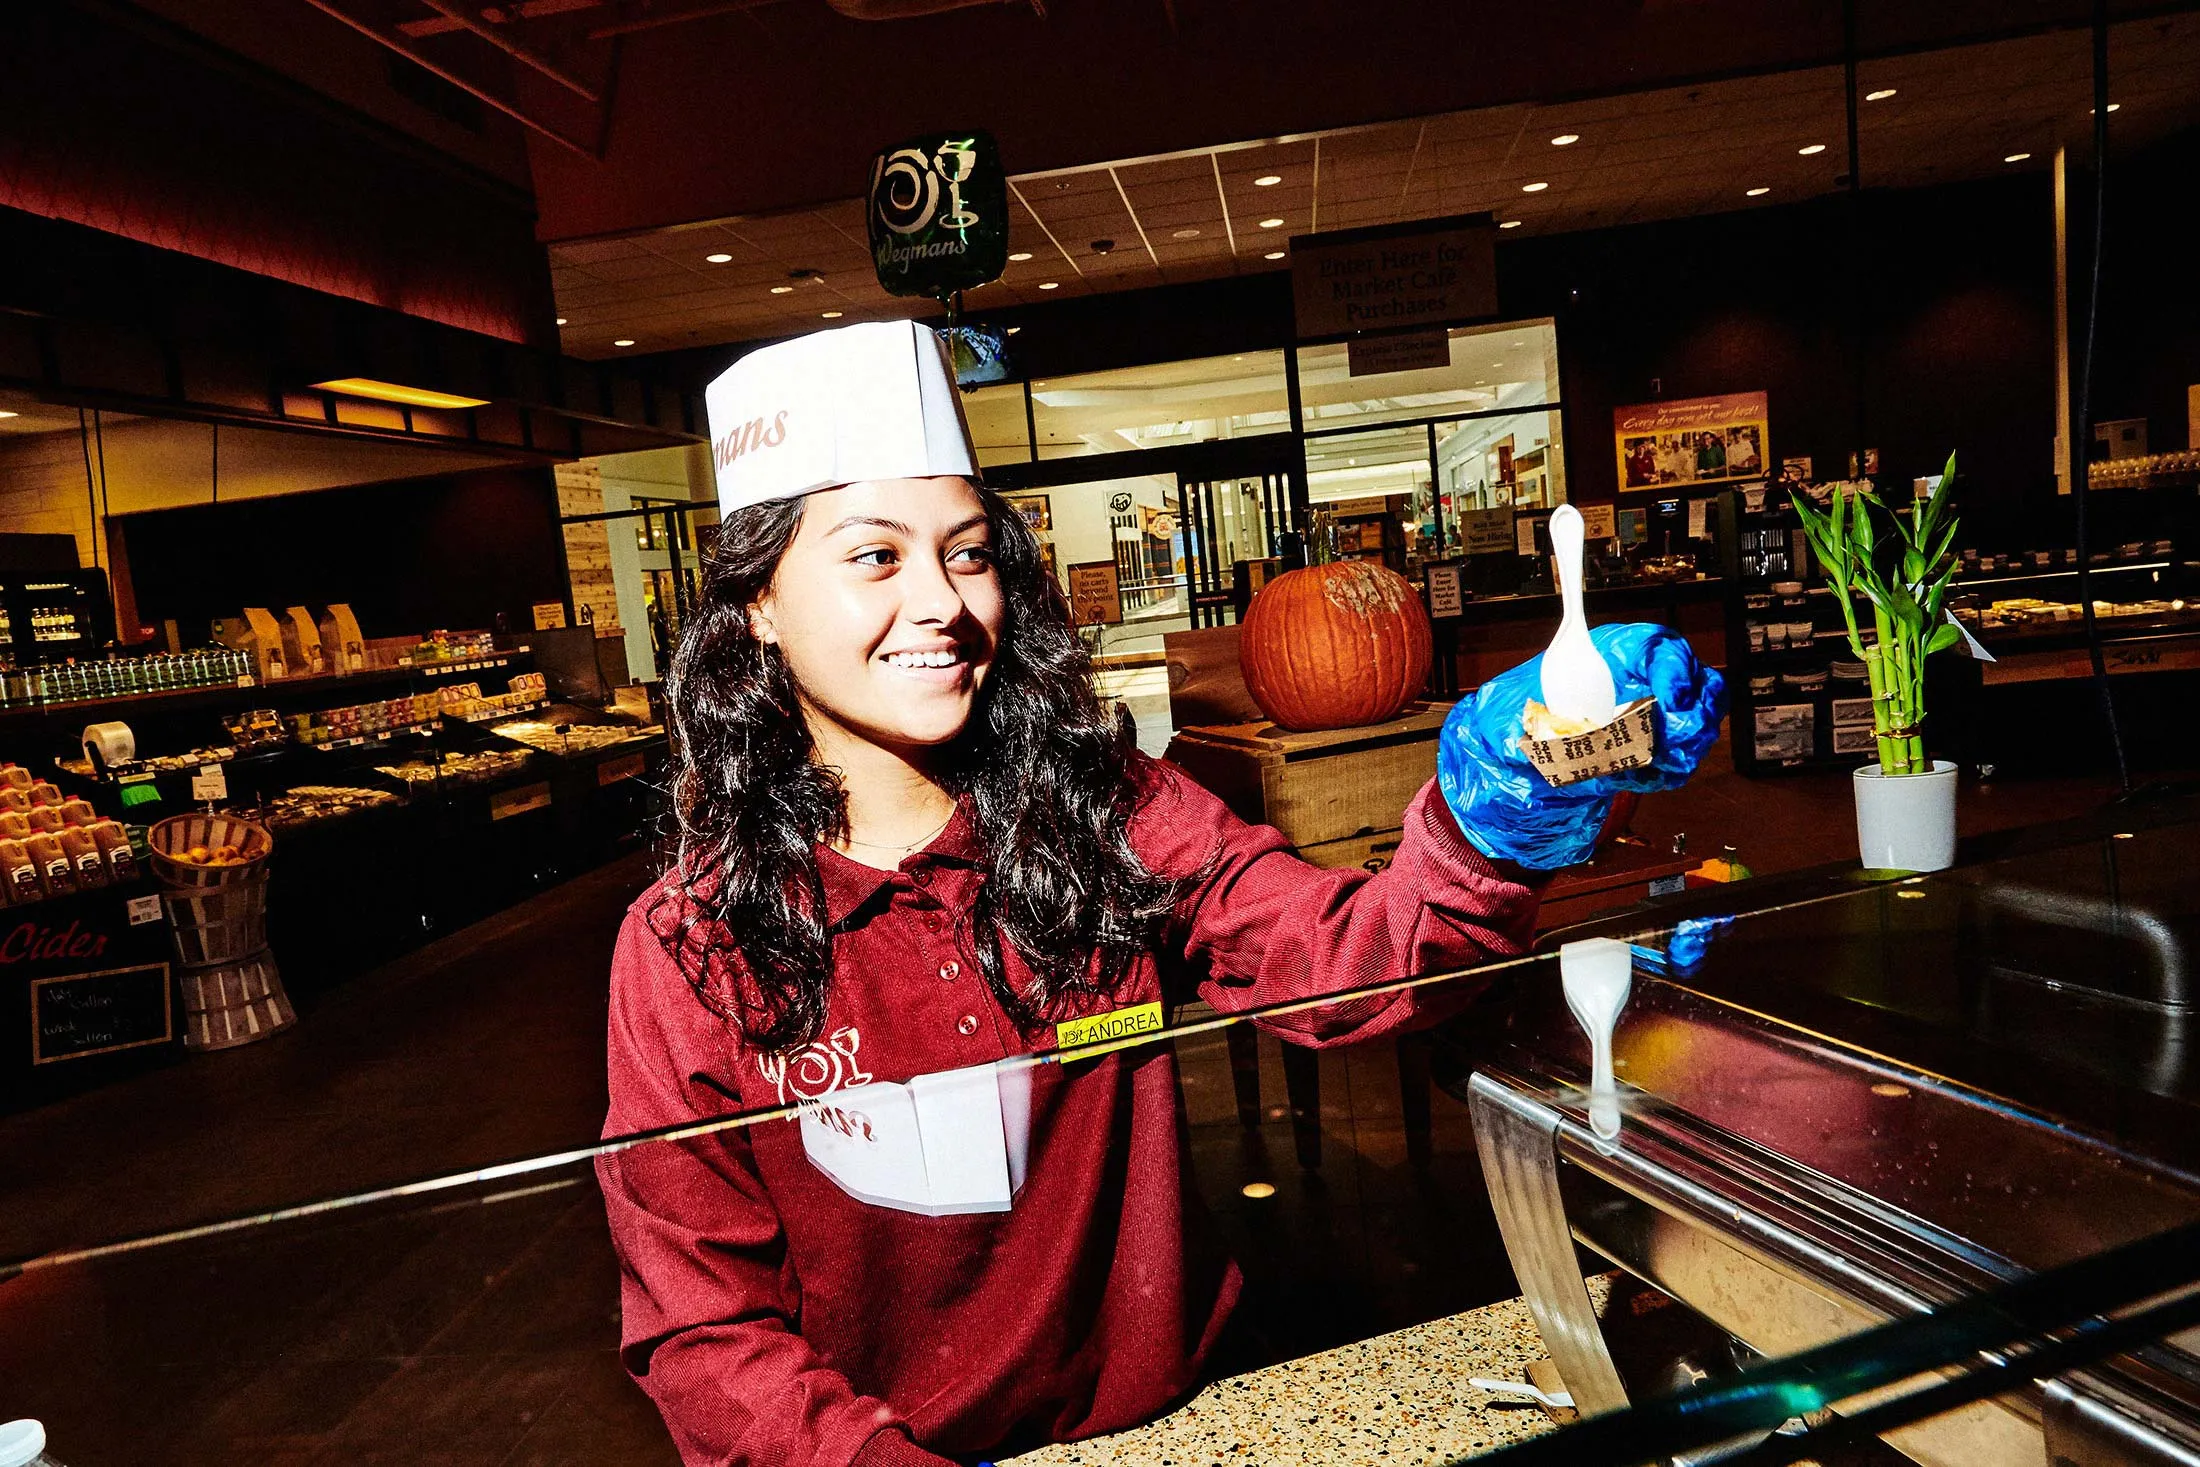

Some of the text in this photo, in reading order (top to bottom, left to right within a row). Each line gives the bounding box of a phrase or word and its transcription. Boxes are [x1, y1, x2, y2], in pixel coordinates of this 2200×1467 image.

[876, 234, 967, 275] Wegmans
[1320, 243, 1466, 278] Enter Here for
[1331, 275, 1404, 301] Market
[1346, 296, 1448, 321] Purchases
[1623, 417, 1656, 431] Every
[1658, 414, 1676, 429] day
[1677, 414, 1698, 426] you
[1735, 404, 1760, 419] best!
[1080, 585, 1108, 594] beyond
[1093, 594, 1114, 604] point
[0, 917, 111, 964] Cider
[1088, 1012, 1159, 1043] ANDREA
